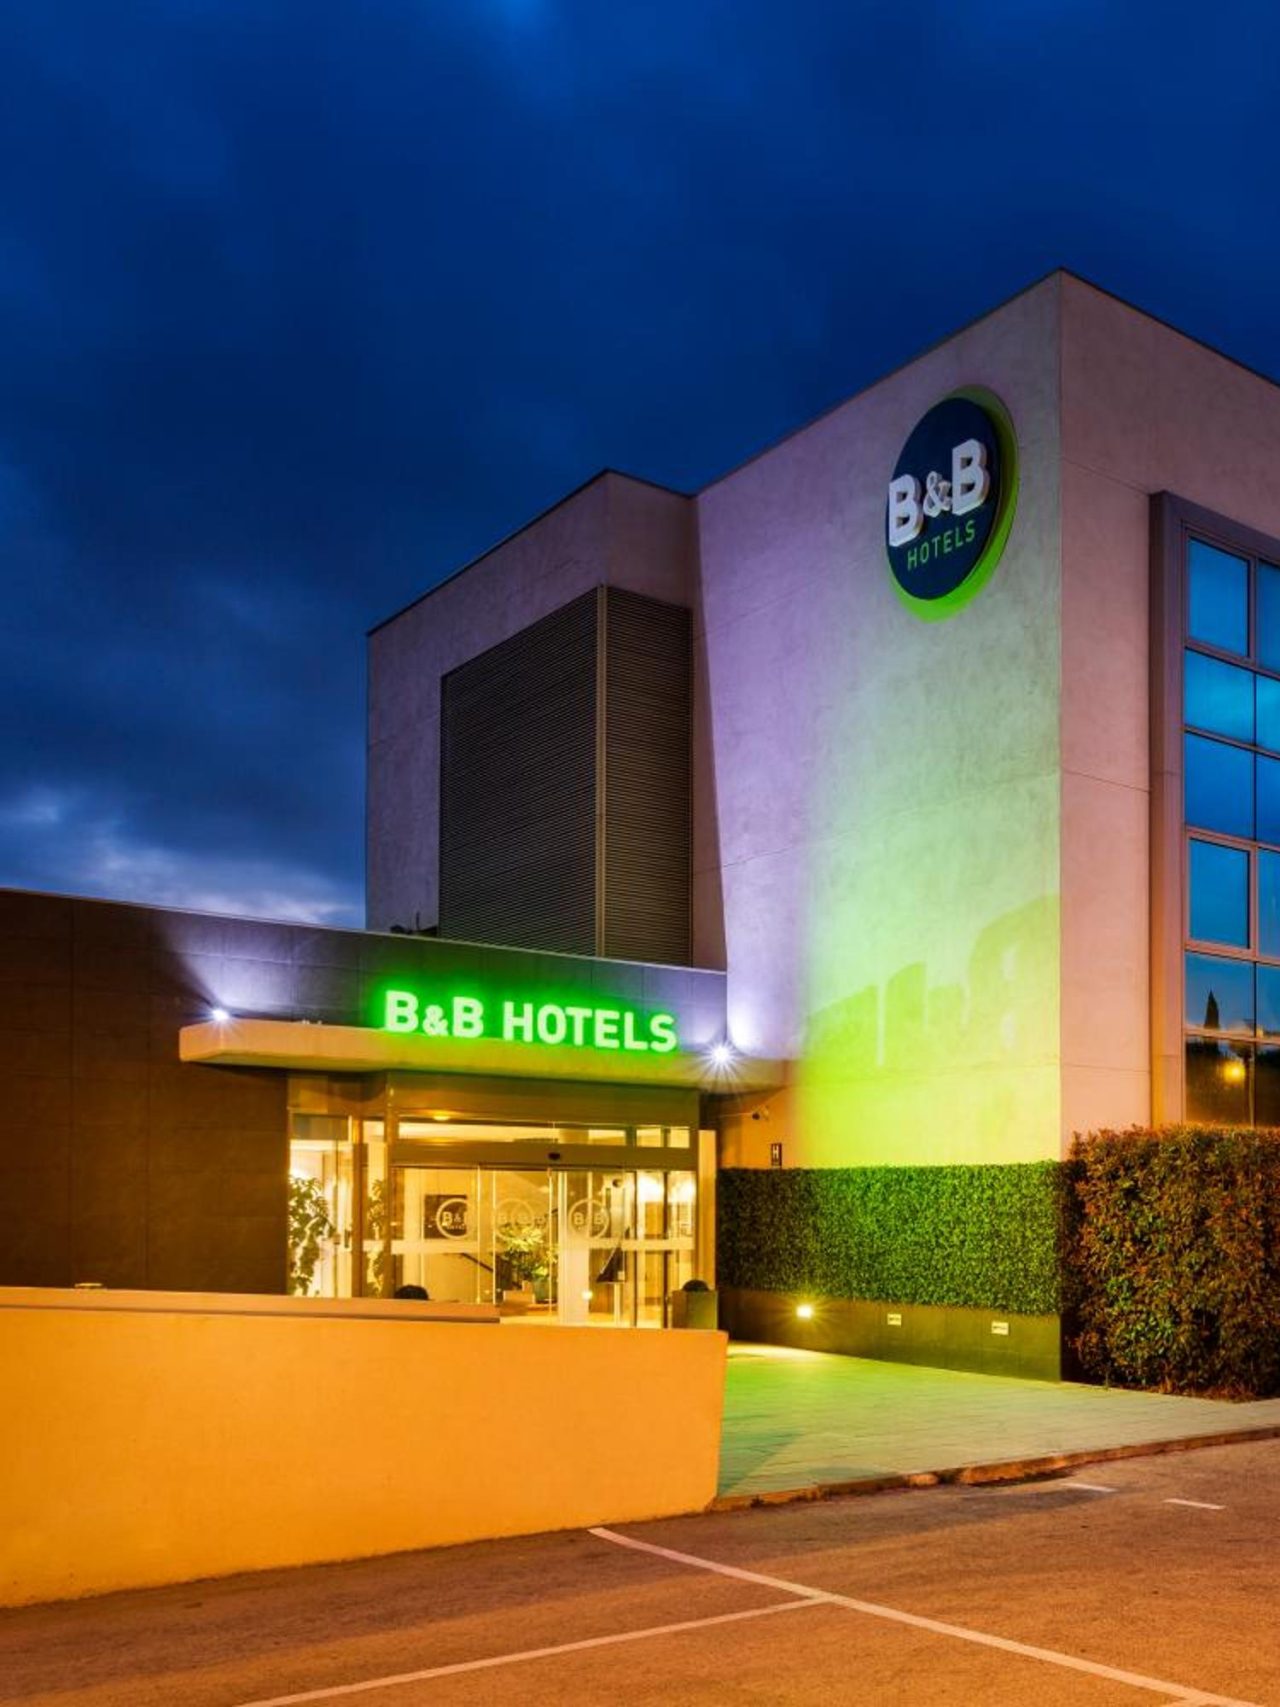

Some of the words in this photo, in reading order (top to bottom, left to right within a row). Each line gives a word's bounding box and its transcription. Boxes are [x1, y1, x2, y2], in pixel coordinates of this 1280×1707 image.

[888, 438, 990, 548] B&B
[907, 519, 976, 571] HOTELS
[384, 989, 485, 1037] B&B
[502, 1000, 678, 1052] HOTELS
